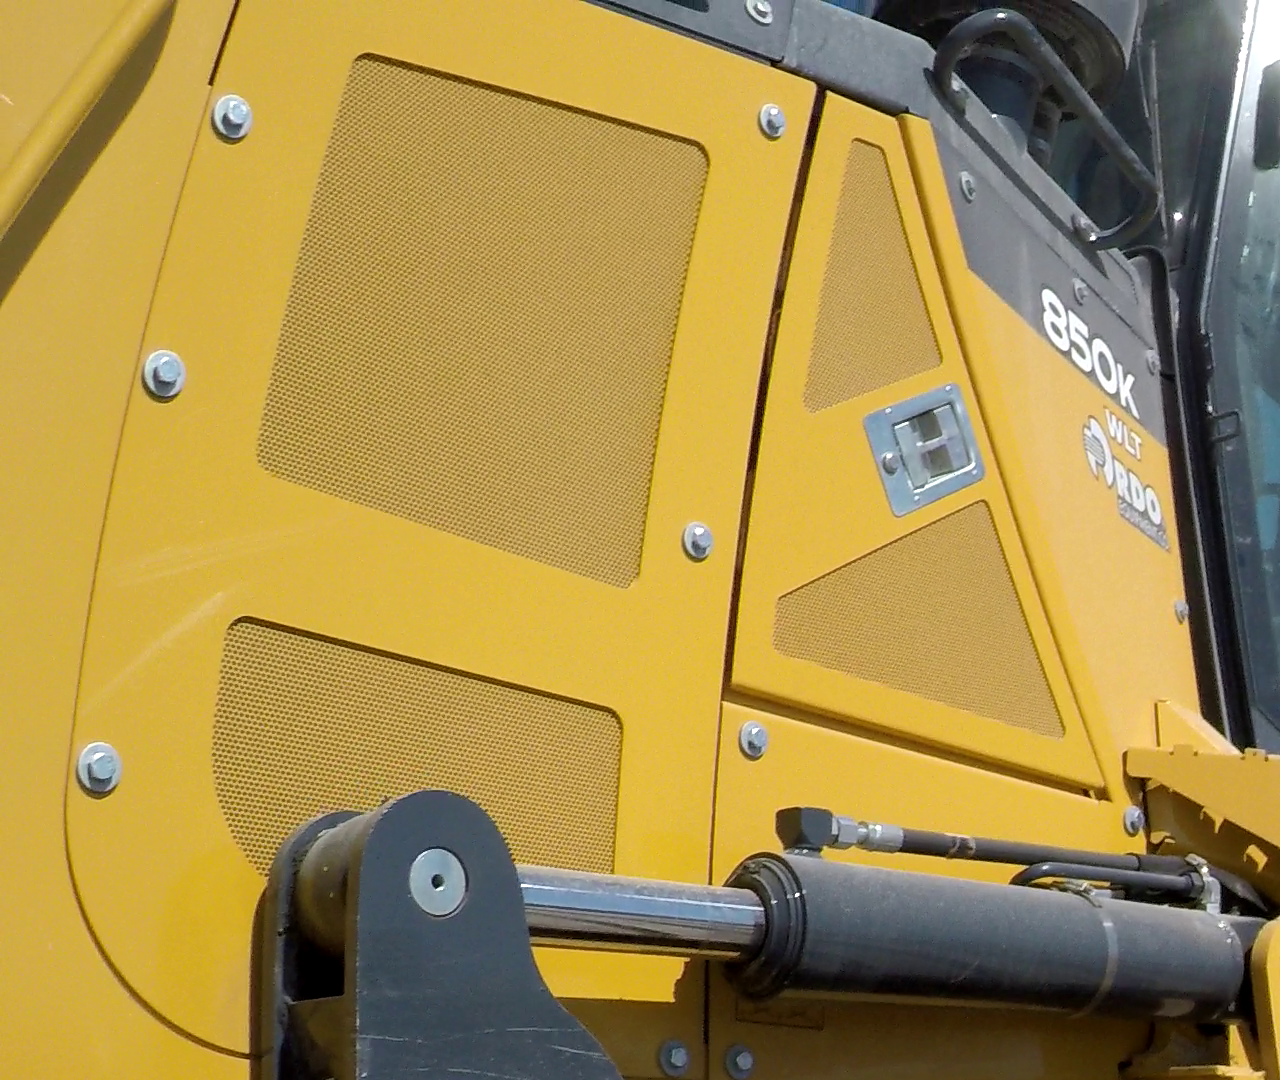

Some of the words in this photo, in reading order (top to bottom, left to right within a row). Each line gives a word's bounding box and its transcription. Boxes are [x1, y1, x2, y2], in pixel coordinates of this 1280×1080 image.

[1041, 288, 1141, 420] 850K
[1104, 408, 1142, 461] WLT
[1114, 459, 1162, 526] RDO
